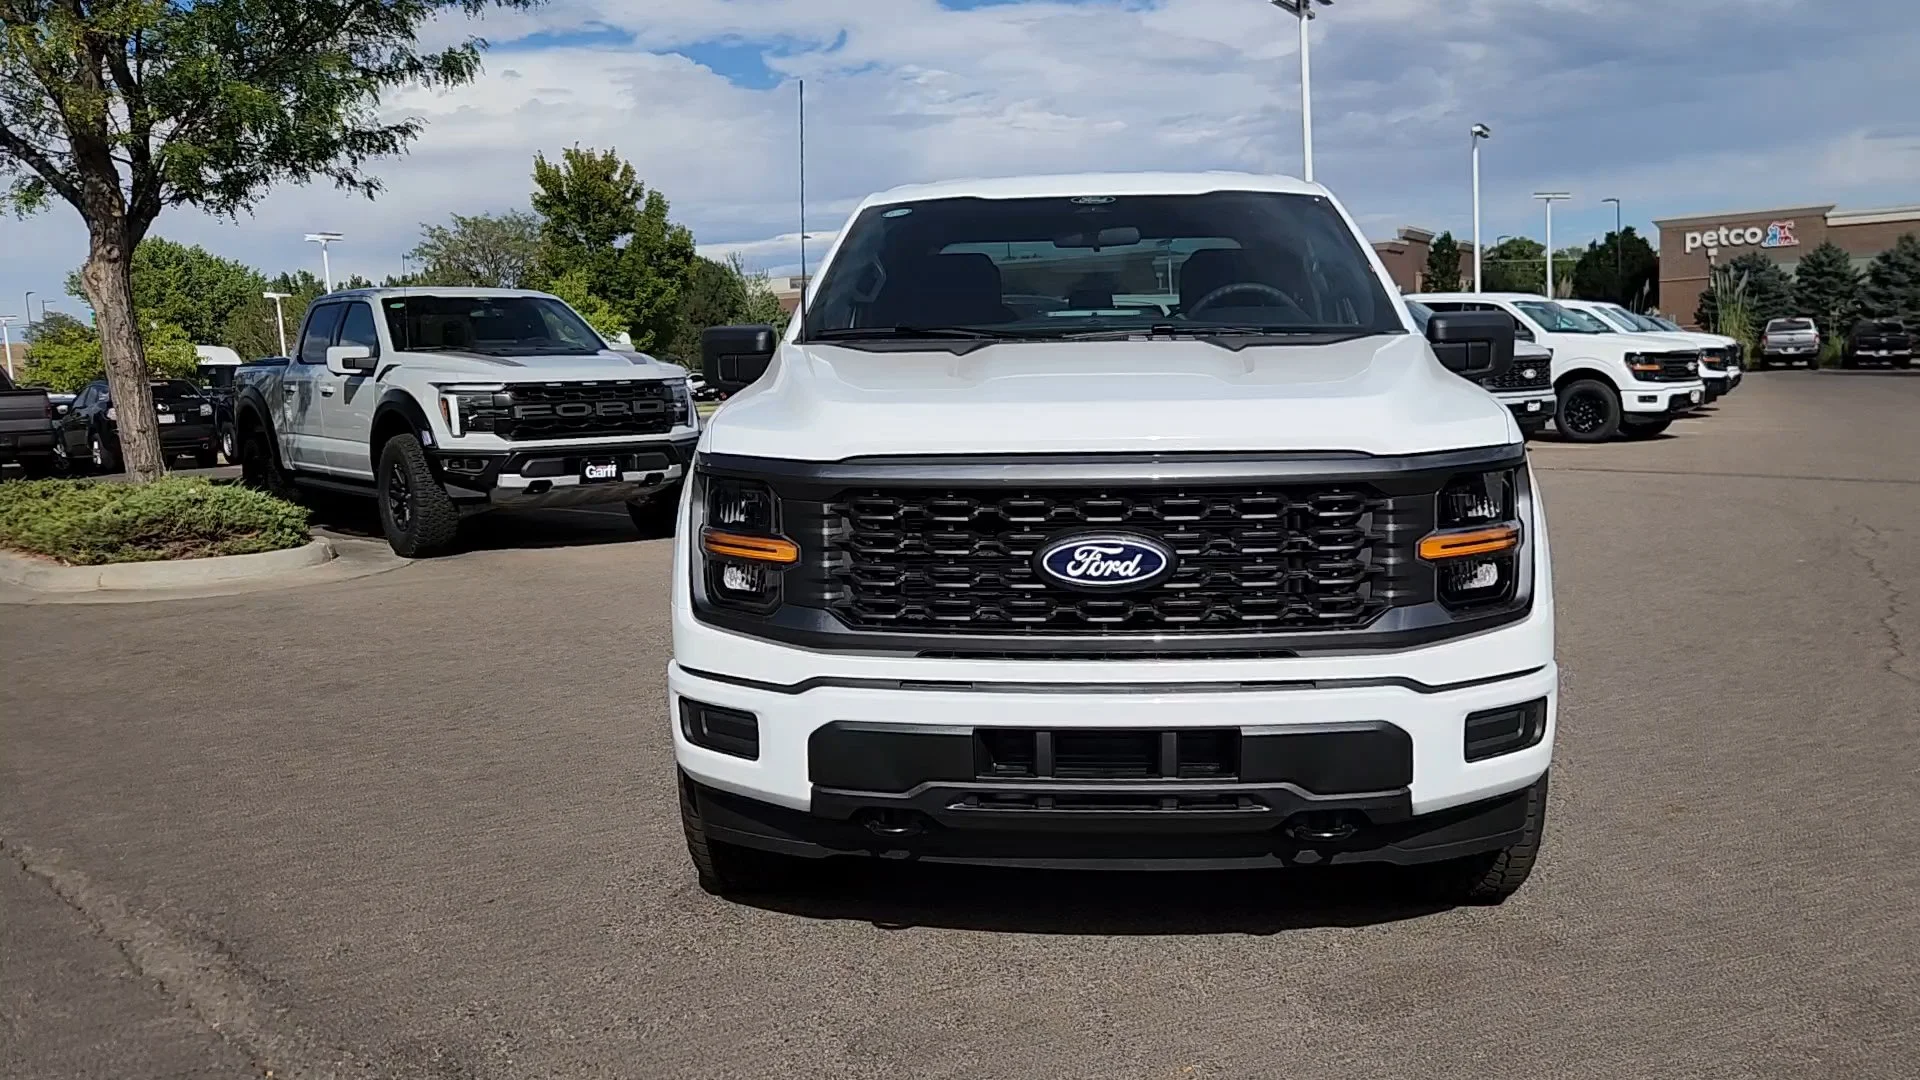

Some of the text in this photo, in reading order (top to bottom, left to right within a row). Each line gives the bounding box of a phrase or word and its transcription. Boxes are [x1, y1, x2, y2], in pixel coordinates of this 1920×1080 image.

[1685, 226, 1763, 253] petco
[513, 400, 665, 419] FORD
[585, 464, 617, 479] Garff
[1066, 545, 1143, 577] Ford
